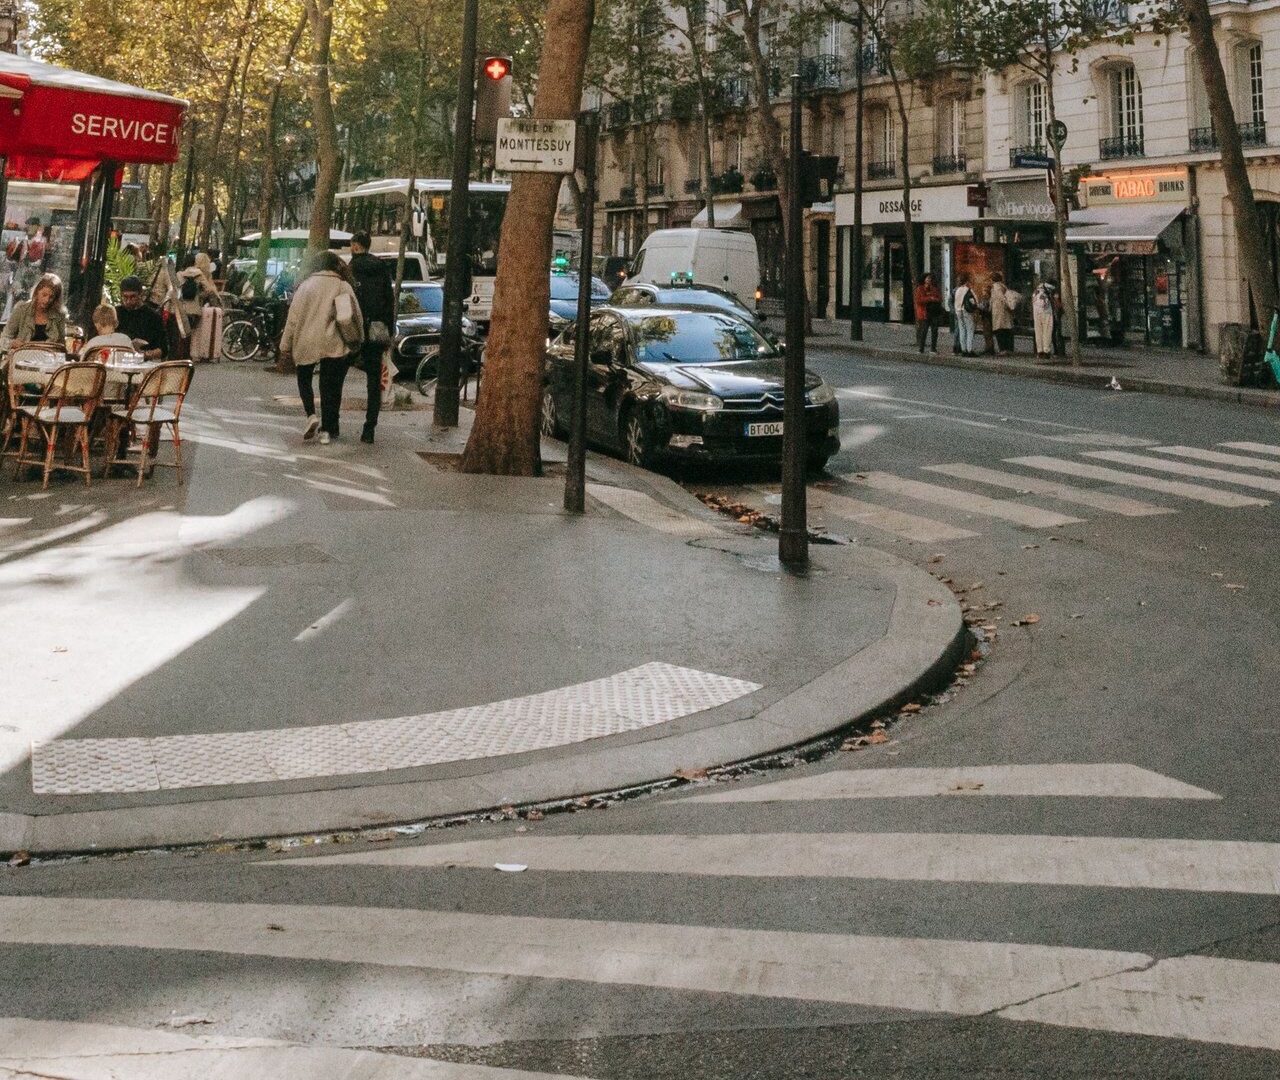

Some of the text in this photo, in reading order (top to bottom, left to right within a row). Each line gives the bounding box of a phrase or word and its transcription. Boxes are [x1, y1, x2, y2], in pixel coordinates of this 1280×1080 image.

[71, 113, 169, 144] SERVICE
[519, 124, 554, 133] RUE DE
[499, 138, 571, 152] MONTTESSUY
[553, 158, 564, 166] 15
[1113, 179, 1156, 198] TABAC
[1159, 180, 1185, 192] DRINKS
[879, 199, 922, 213] DESSAGE
